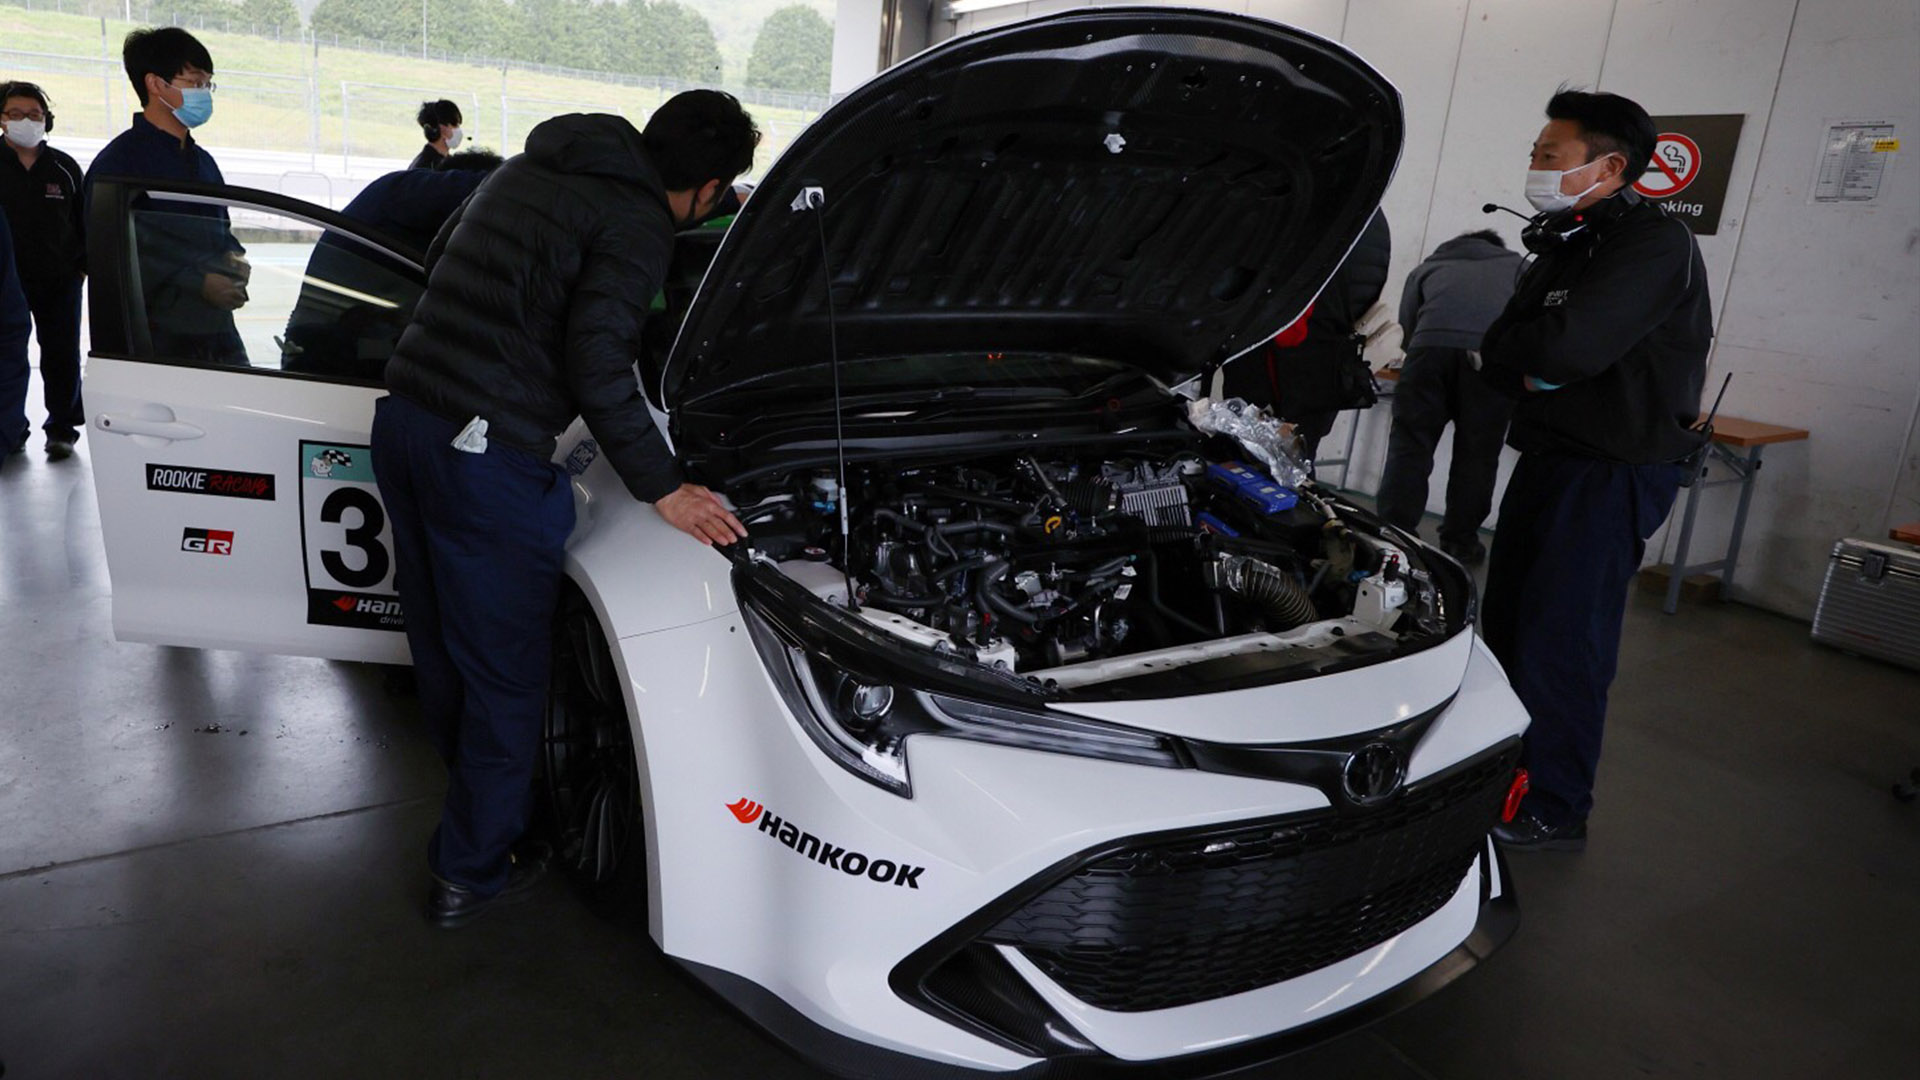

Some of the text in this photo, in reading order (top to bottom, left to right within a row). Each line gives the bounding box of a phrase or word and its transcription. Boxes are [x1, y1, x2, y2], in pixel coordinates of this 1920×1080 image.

[152, 468, 270, 496] ROOKIE RACING
[182, 537, 231, 555] GR
[321, 486, 398, 591] 3
[356, 599, 404, 616] Han
